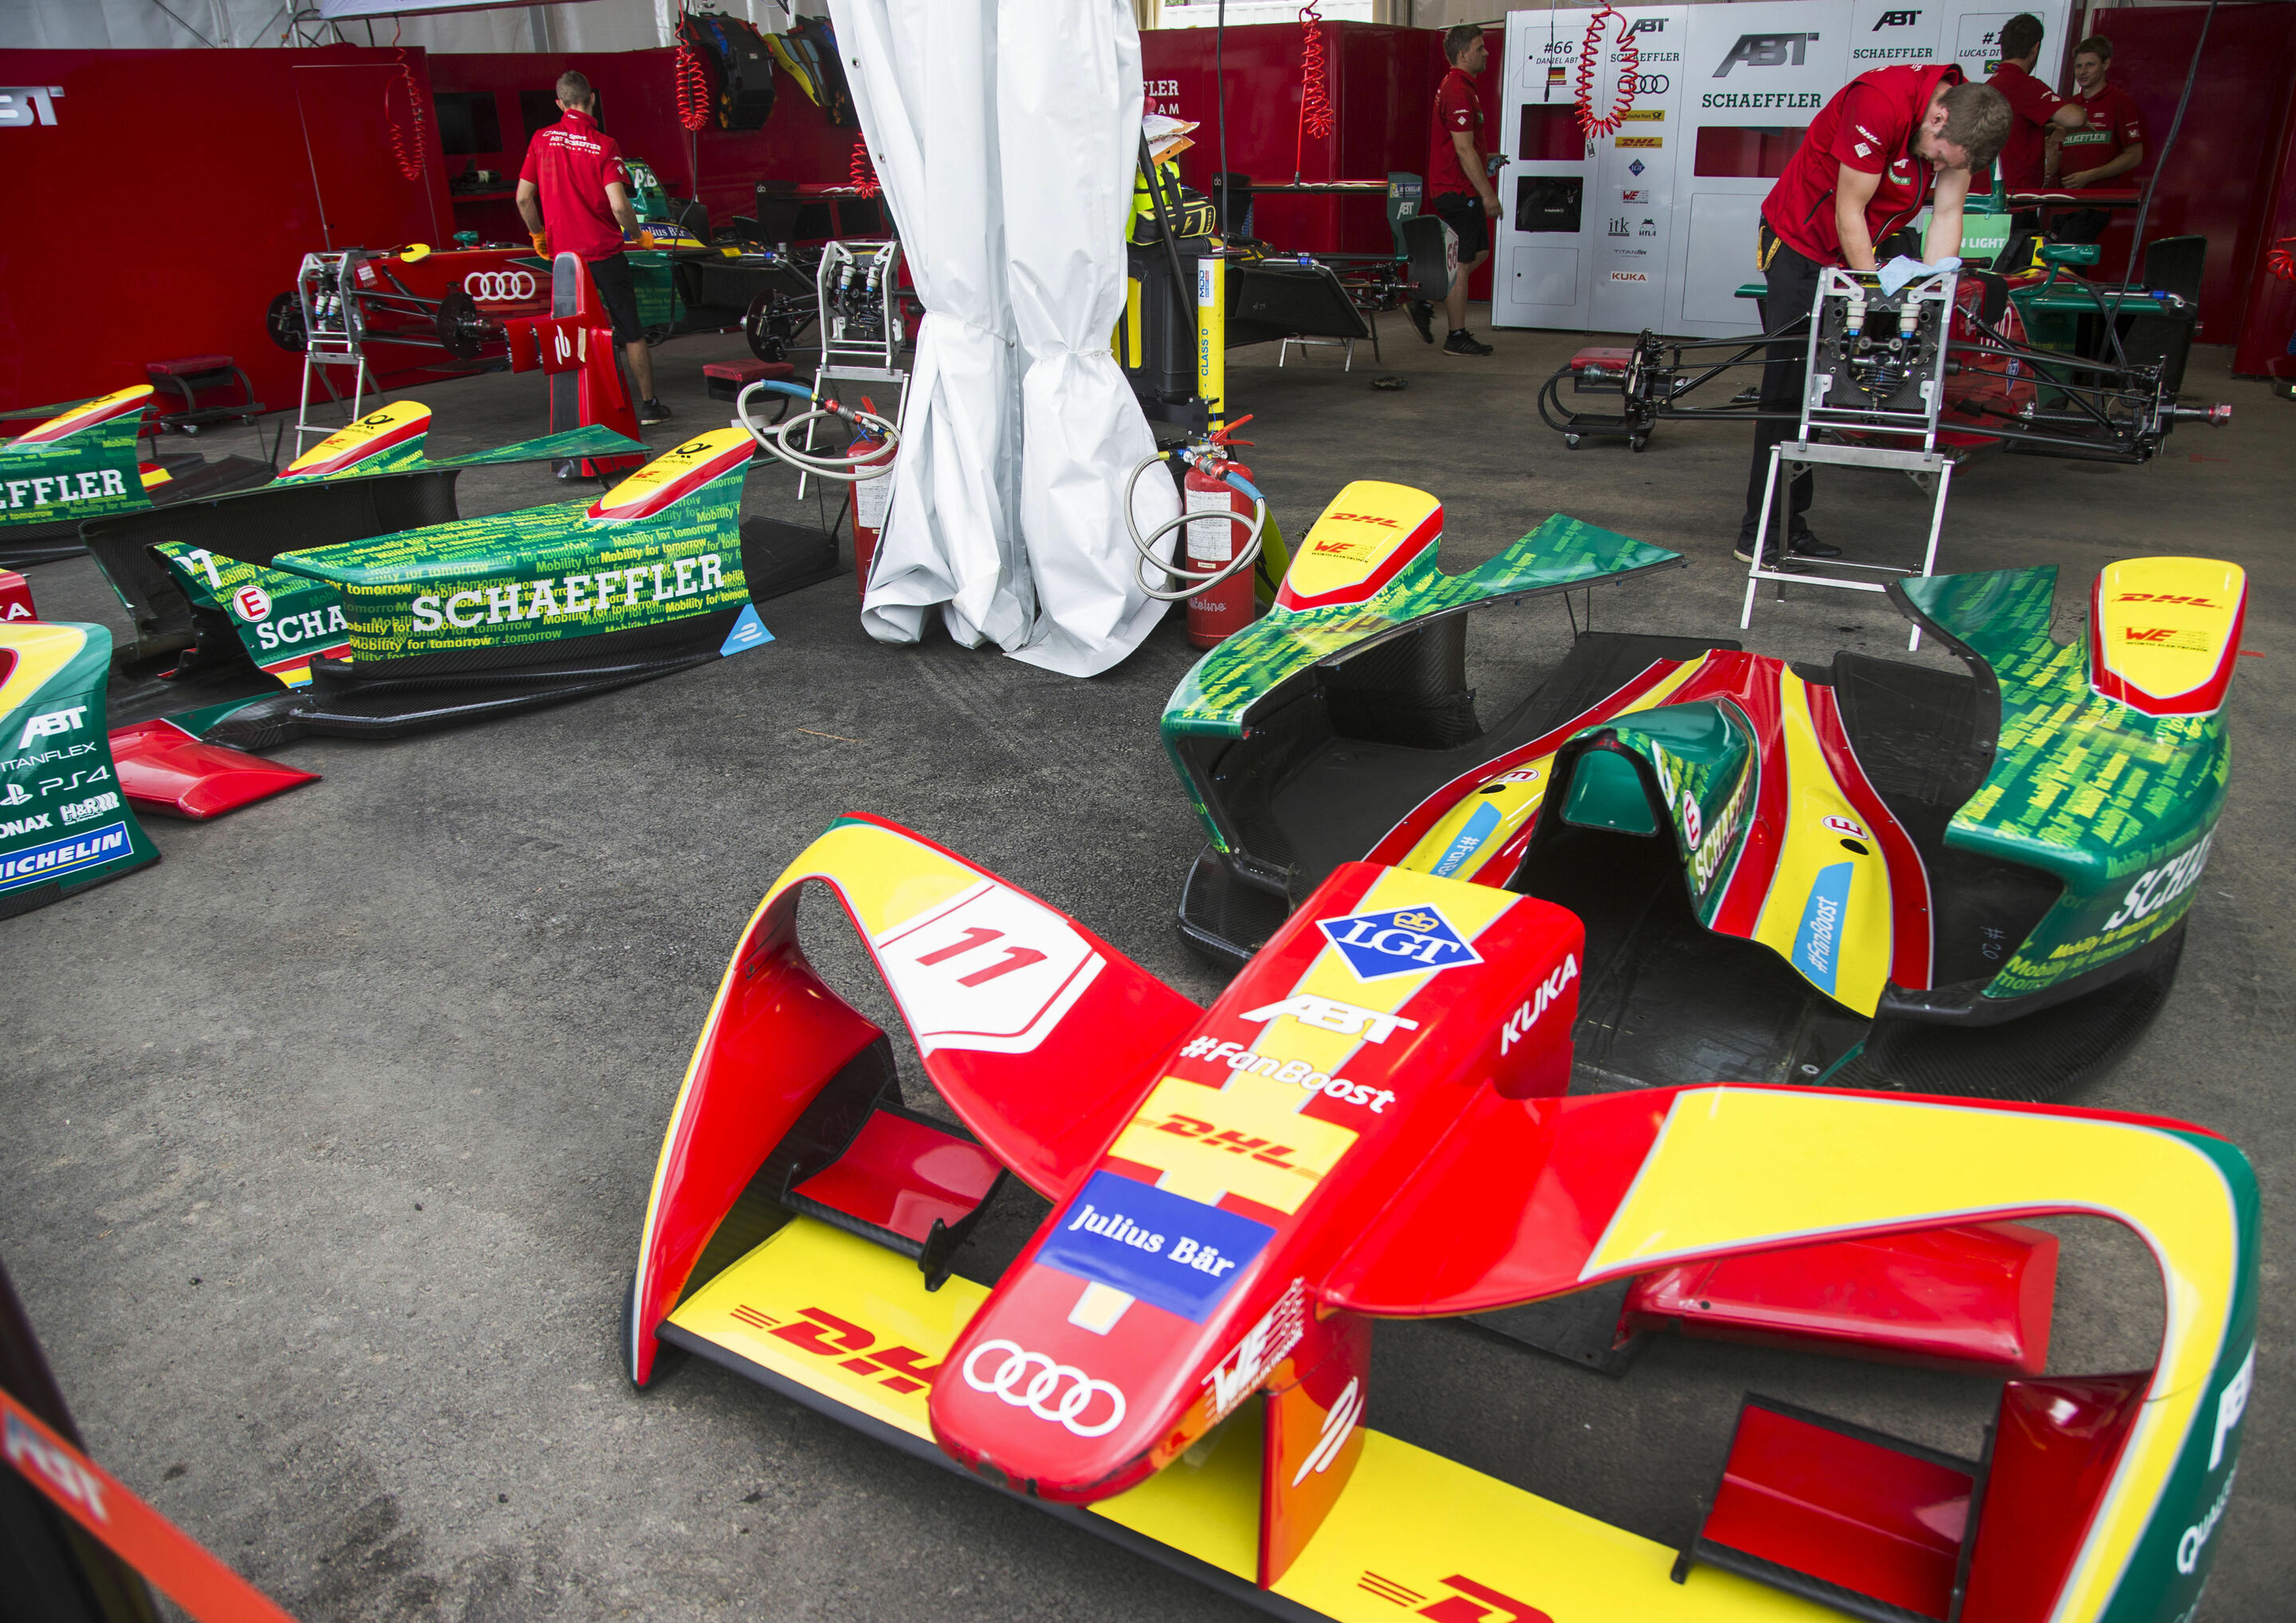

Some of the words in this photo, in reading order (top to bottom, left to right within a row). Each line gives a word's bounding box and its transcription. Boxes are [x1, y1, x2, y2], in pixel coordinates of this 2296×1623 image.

[1626, 18, 1669, 37] ABT
[1872, 10, 1922, 31] ABT
[1543, 41, 1573, 54] #66
[1712, 32, 1819, 77] ABT
[1854, 48, 1932, 59] SCHAEFFLER
[1959, 49, 1987, 57] LUCAS
[1702, 93, 1822, 108] SCHAEFFLER
[569, 132, 588, 142] Sport
[1622, 138, 1656, 147] DHL
[1622, 190, 1640, 200] WE
[1397, 201, 1414, 220] ABT
[1609, 217, 1630, 233] itk
[1969, 238, 2006, 249] LIGHT
[1447, 239, 1459, 273] 66
[1612, 273, 1647, 281] KUKA
[0, 469, 128, 510] FFLER
[672, 523, 718, 538] tomorrow
[1327, 513, 1400, 529] DHL
[600, 546, 641, 563] Mobility
[662, 537, 706, 553] tomorrow
[1314, 540, 1356, 553] WE
[536, 556, 582, 573] Mobility
[586, 554, 601, 566] for
[347, 583, 412, 595] tomorrow
[412, 554, 725, 632] SCHAEFFLER
[239, 590, 266, 619] E
[665, 598, 704, 614] Mobility
[706, 595, 718, 606] for
[2116, 592, 2216, 608] DHL
[2125, 627, 2178, 642] WE
[349, 638, 403, 652] Mobility
[407, 639, 425, 650] for
[18, 705, 88, 750] ABT
[38, 765, 111, 796] PS4
[0, 831, 123, 878] ICHELIN
[1336, 918, 1461, 965] LGT
[1807, 894, 1839, 974] #FanBoost
[914, 925, 1049, 988] 11
[1500, 953, 1578, 1056] KUKA
[1239, 992, 1420, 1045] ABT
[1179, 1035, 1396, 1114] #FanBoost
[1156, 1113, 1297, 1170] DHL
[1067, 1204, 1166, 1254] Julius
[1167, 1236, 1235, 1277] Bär
[767, 1307, 943, 1395] DH
